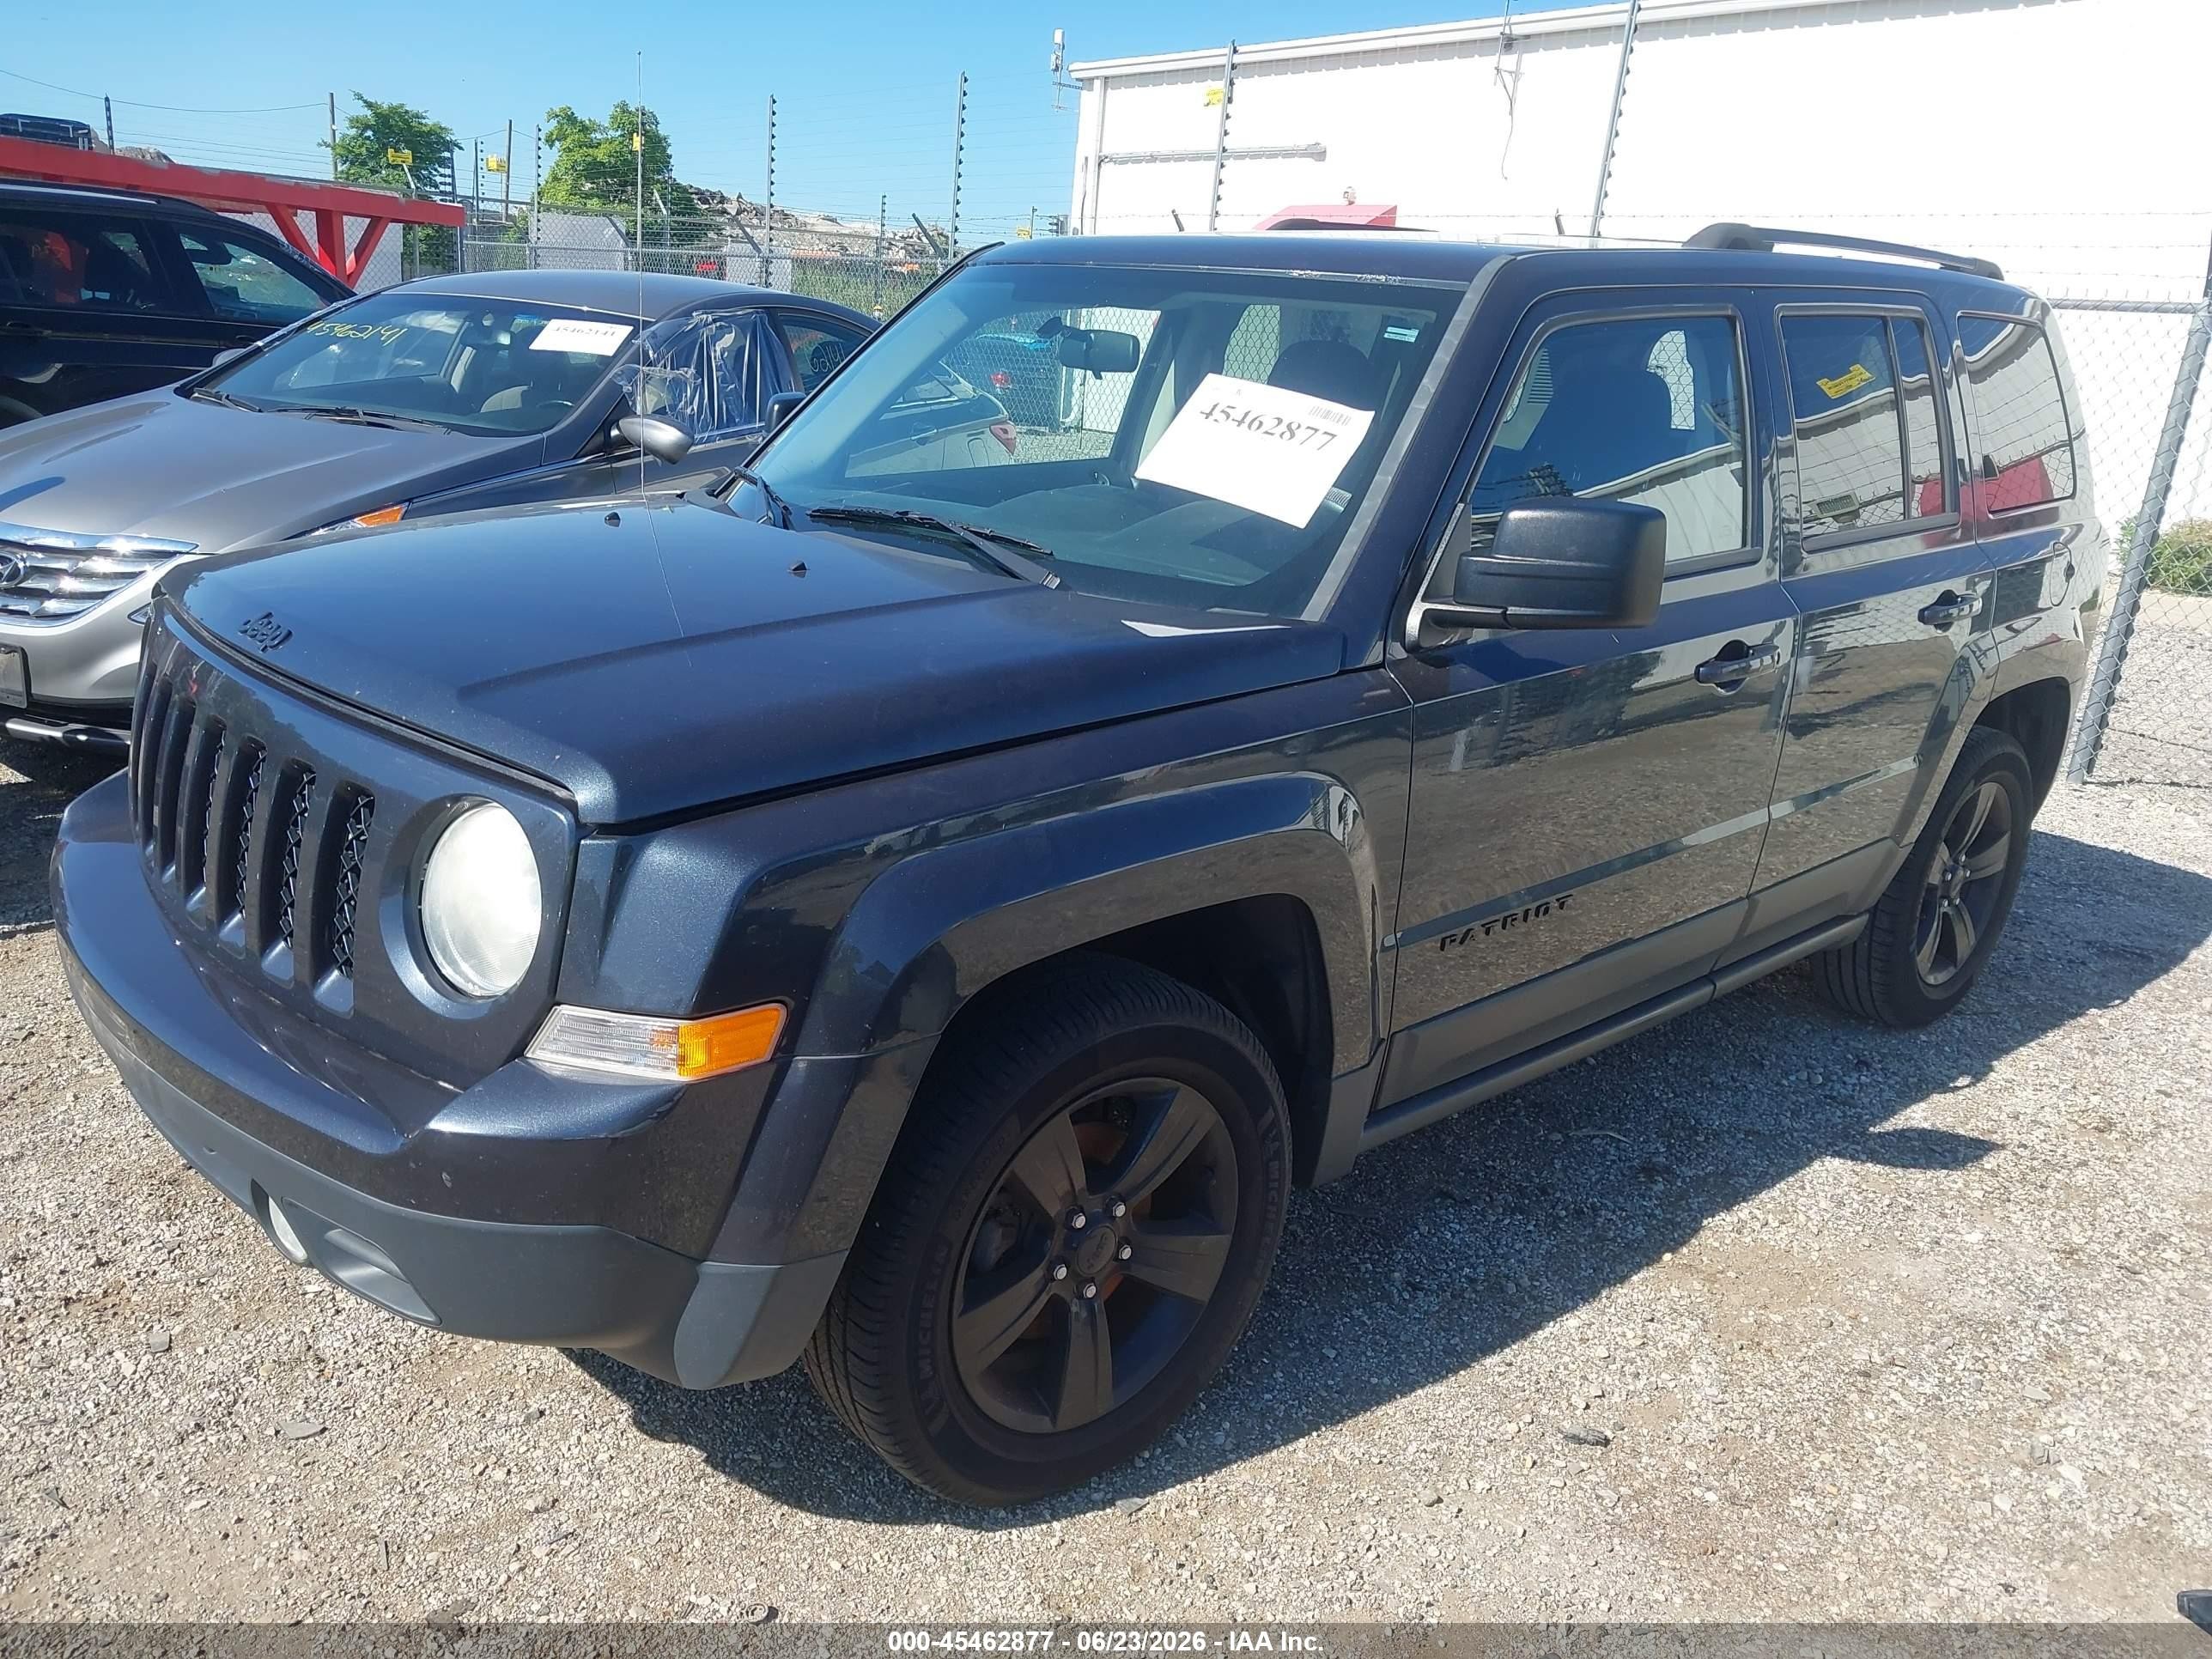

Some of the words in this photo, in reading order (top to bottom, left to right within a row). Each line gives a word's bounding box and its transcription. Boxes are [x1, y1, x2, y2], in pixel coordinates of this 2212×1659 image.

[307, 320, 409, 347] 45462141
[1200, 402, 1338, 452] 45462877
[238, 611, 293, 653] Jeep
[1439, 894, 1573, 951] PATRIOT
[1255, 1160, 1279, 1278] MICHL
